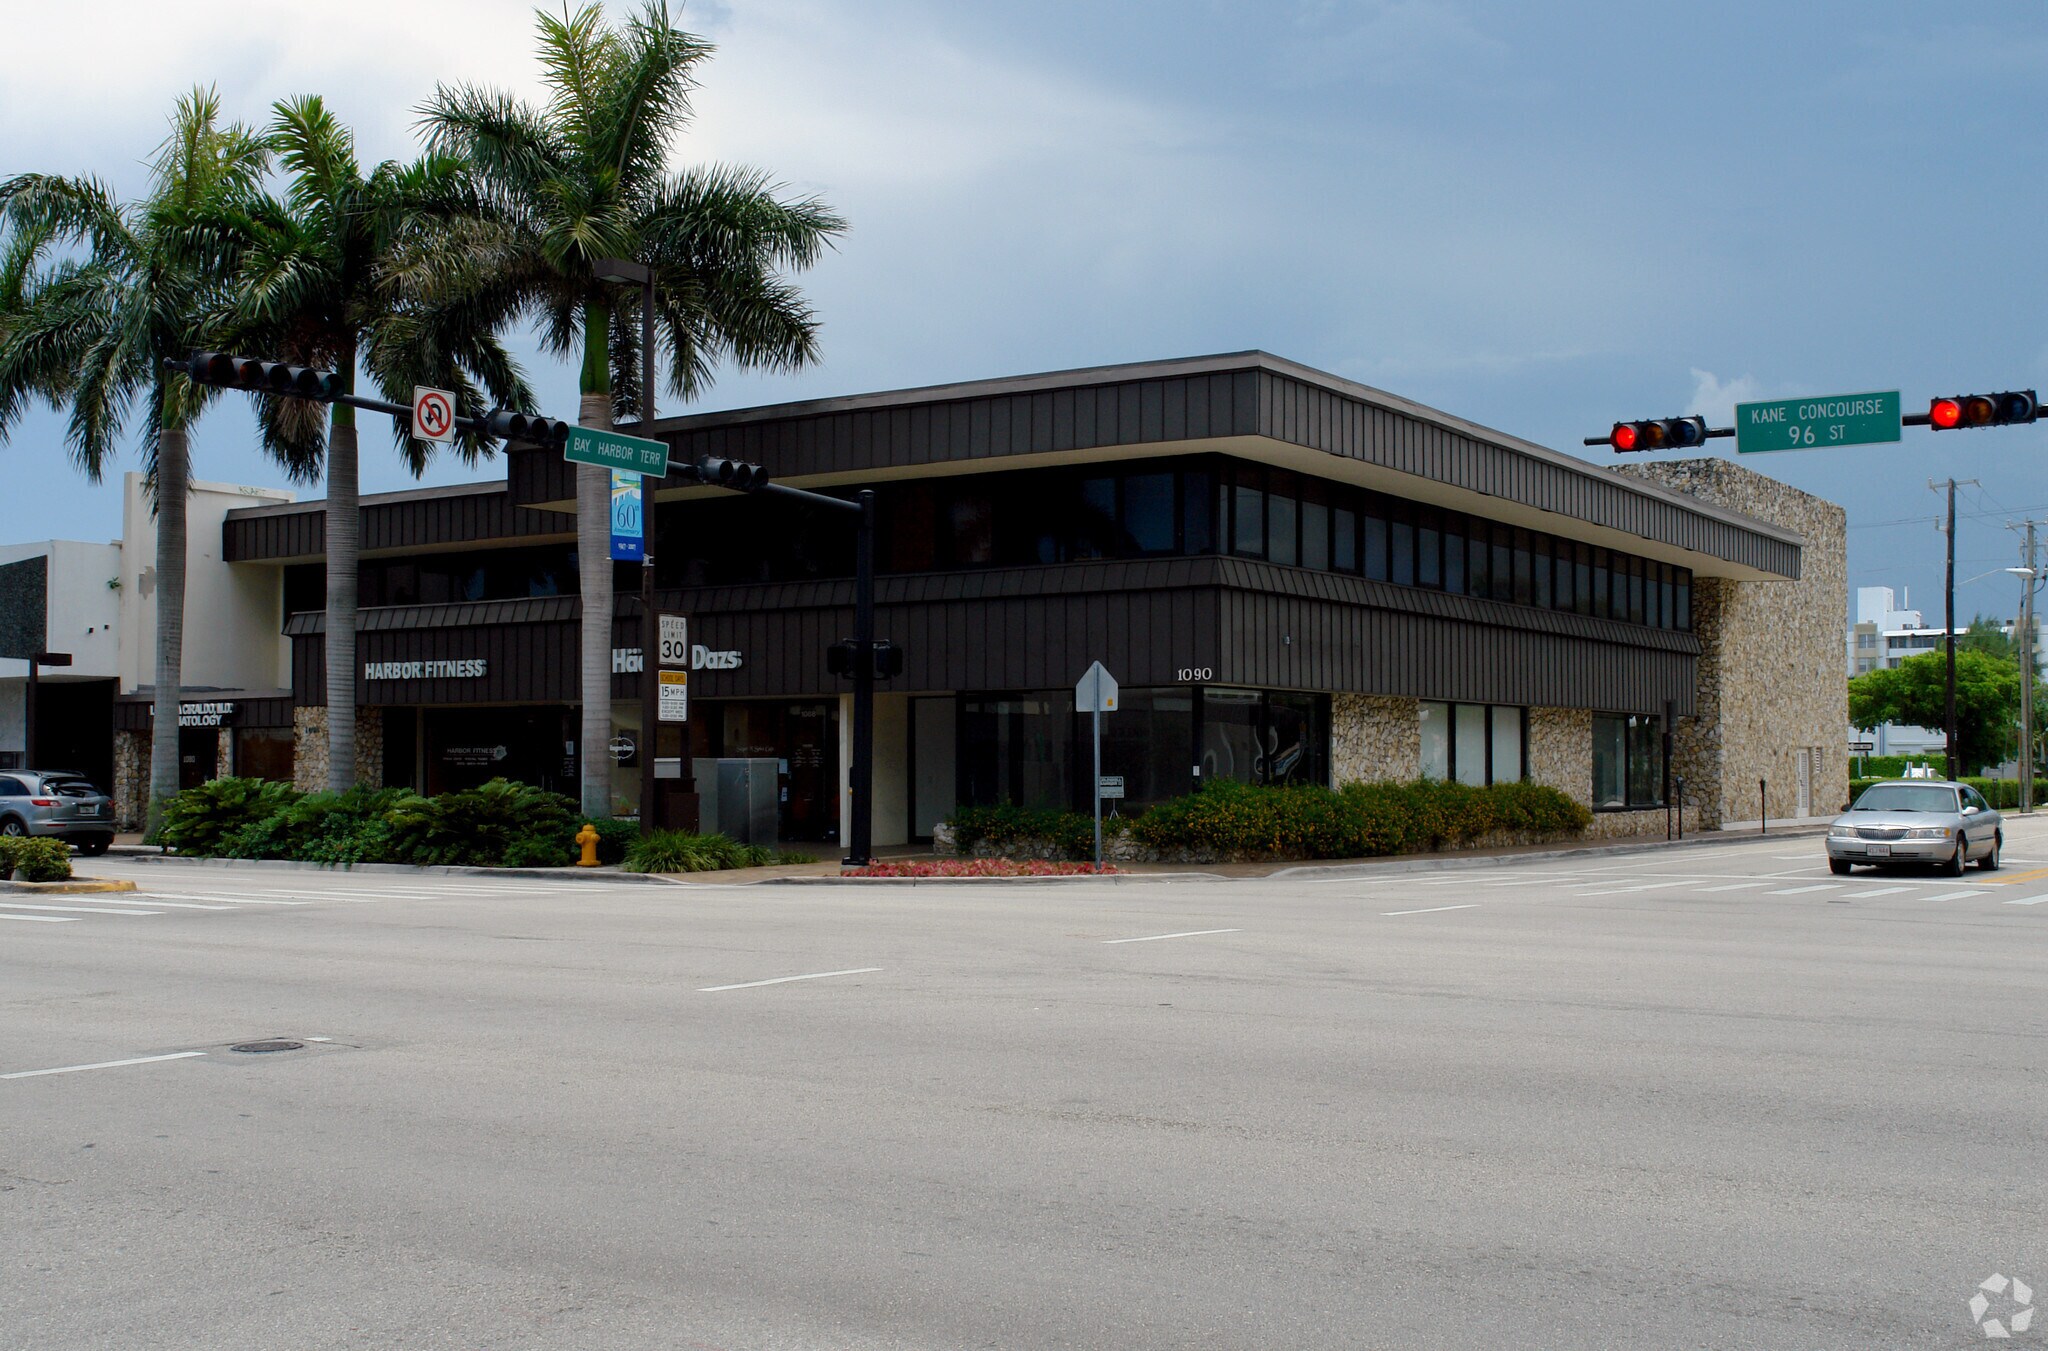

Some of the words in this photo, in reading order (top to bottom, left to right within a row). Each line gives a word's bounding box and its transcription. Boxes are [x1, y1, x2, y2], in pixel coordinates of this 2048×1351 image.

[1751, 406, 1787, 424] KANE
[1798, 399, 1883, 420] CONCOURSE
[1788, 426, 1815, 445] 96
[1829, 425, 1846, 440] ST
[574, 437, 591, 453] BAY
[598, 442, 634, 460] HARBOR
[640, 449, 661, 466] TERR
[662, 620, 684, 630] SPEED
[663, 631, 682, 639] LIMIT
[662, 640, 684, 658] 30
[365, 662, 422, 680] HARBOR
[425, 659, 486, 678] FITNESS
[1177, 667, 1213, 681] 1090
[661, 686, 670, 697] 15
[671, 688, 685, 696] MPH
